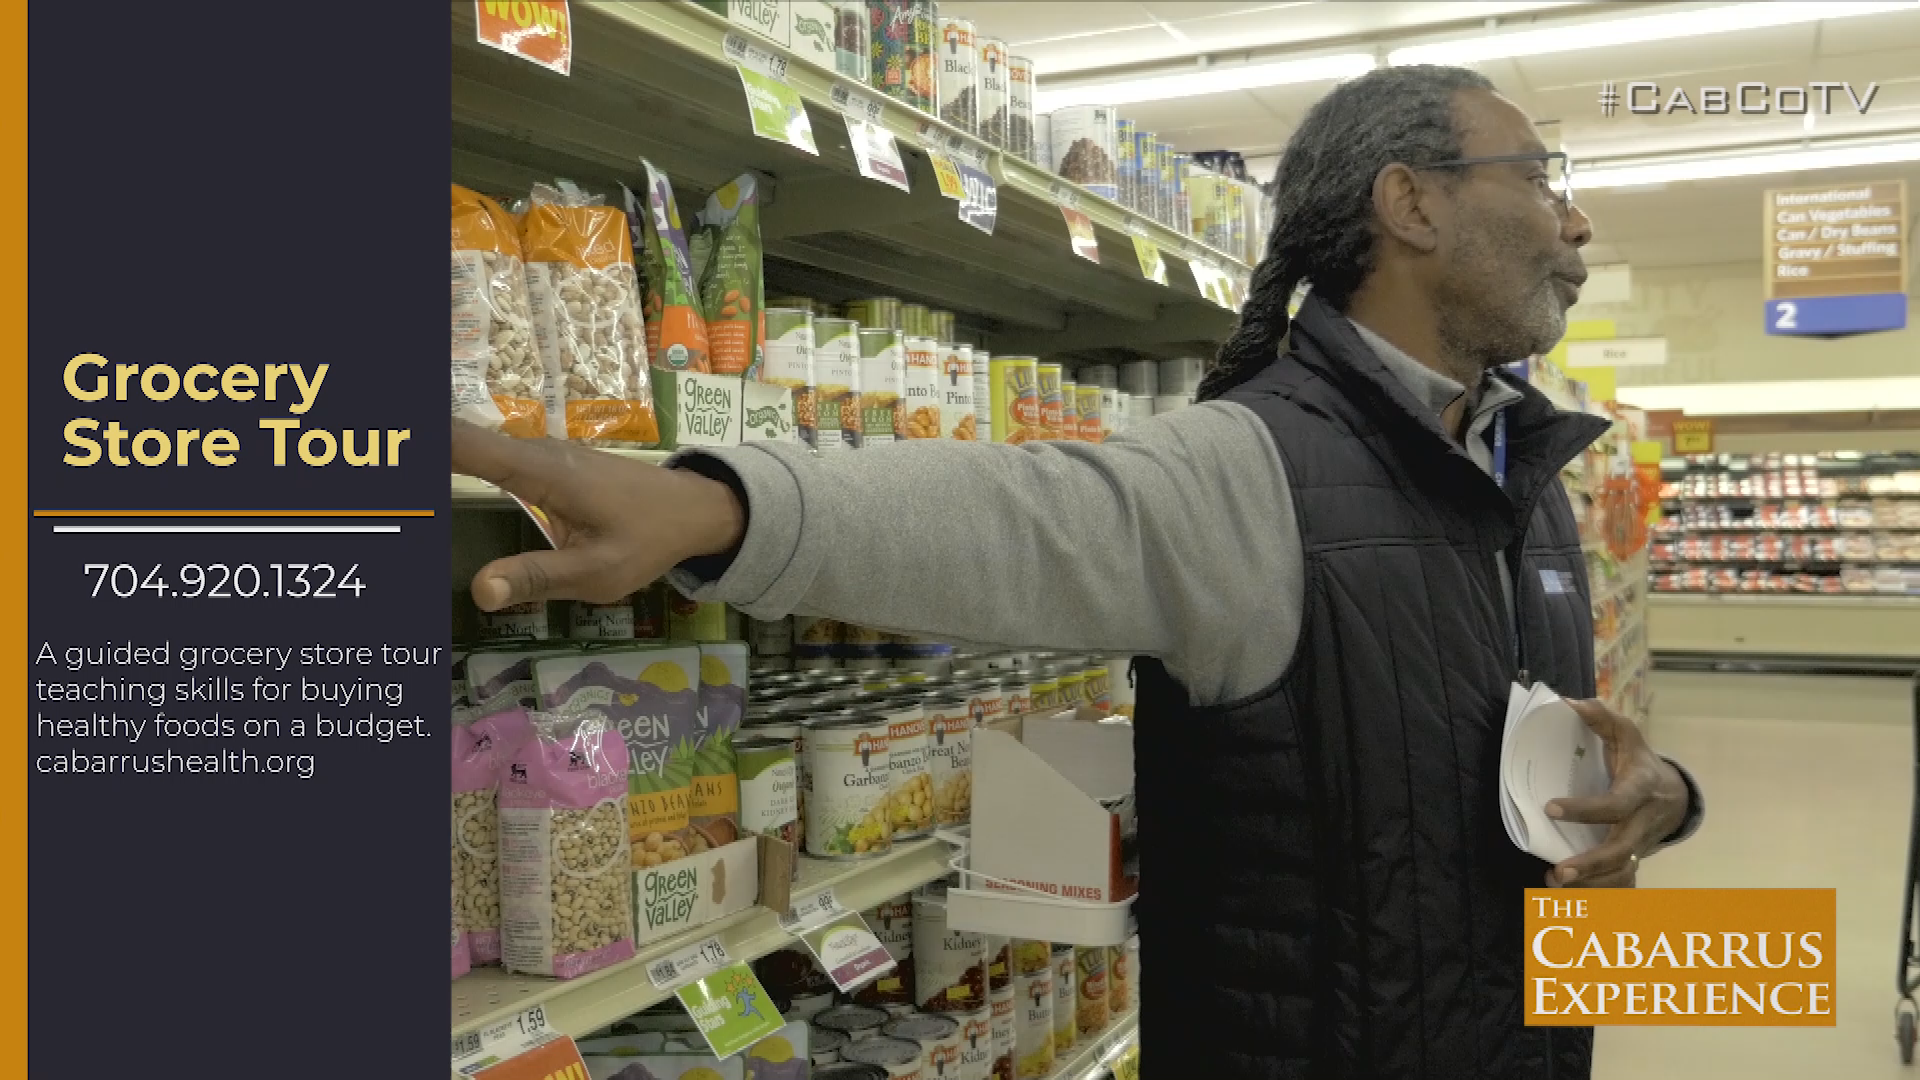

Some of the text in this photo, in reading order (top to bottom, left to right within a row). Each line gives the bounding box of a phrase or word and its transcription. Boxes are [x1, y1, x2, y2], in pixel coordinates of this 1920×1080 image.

[1776, 187, 1872, 206] International
[1776, 205, 1893, 224] Can Vegetables
[1776, 228, 1807, 242] Can
[1820, 226, 1849, 242] Dry
[1851, 223, 1897, 237] Beans
[1778, 247, 1822, 260] Gravy
[1836, 241, 1898, 256] Stuffing
[1777, 264, 1810, 277] Rice
[1775, 302, 1798, 329] 2
[1603, 349, 1628, 359] Rice
[1061, 884, 1102, 901] MIXES
[516, 1007, 545, 1035] 1.59
